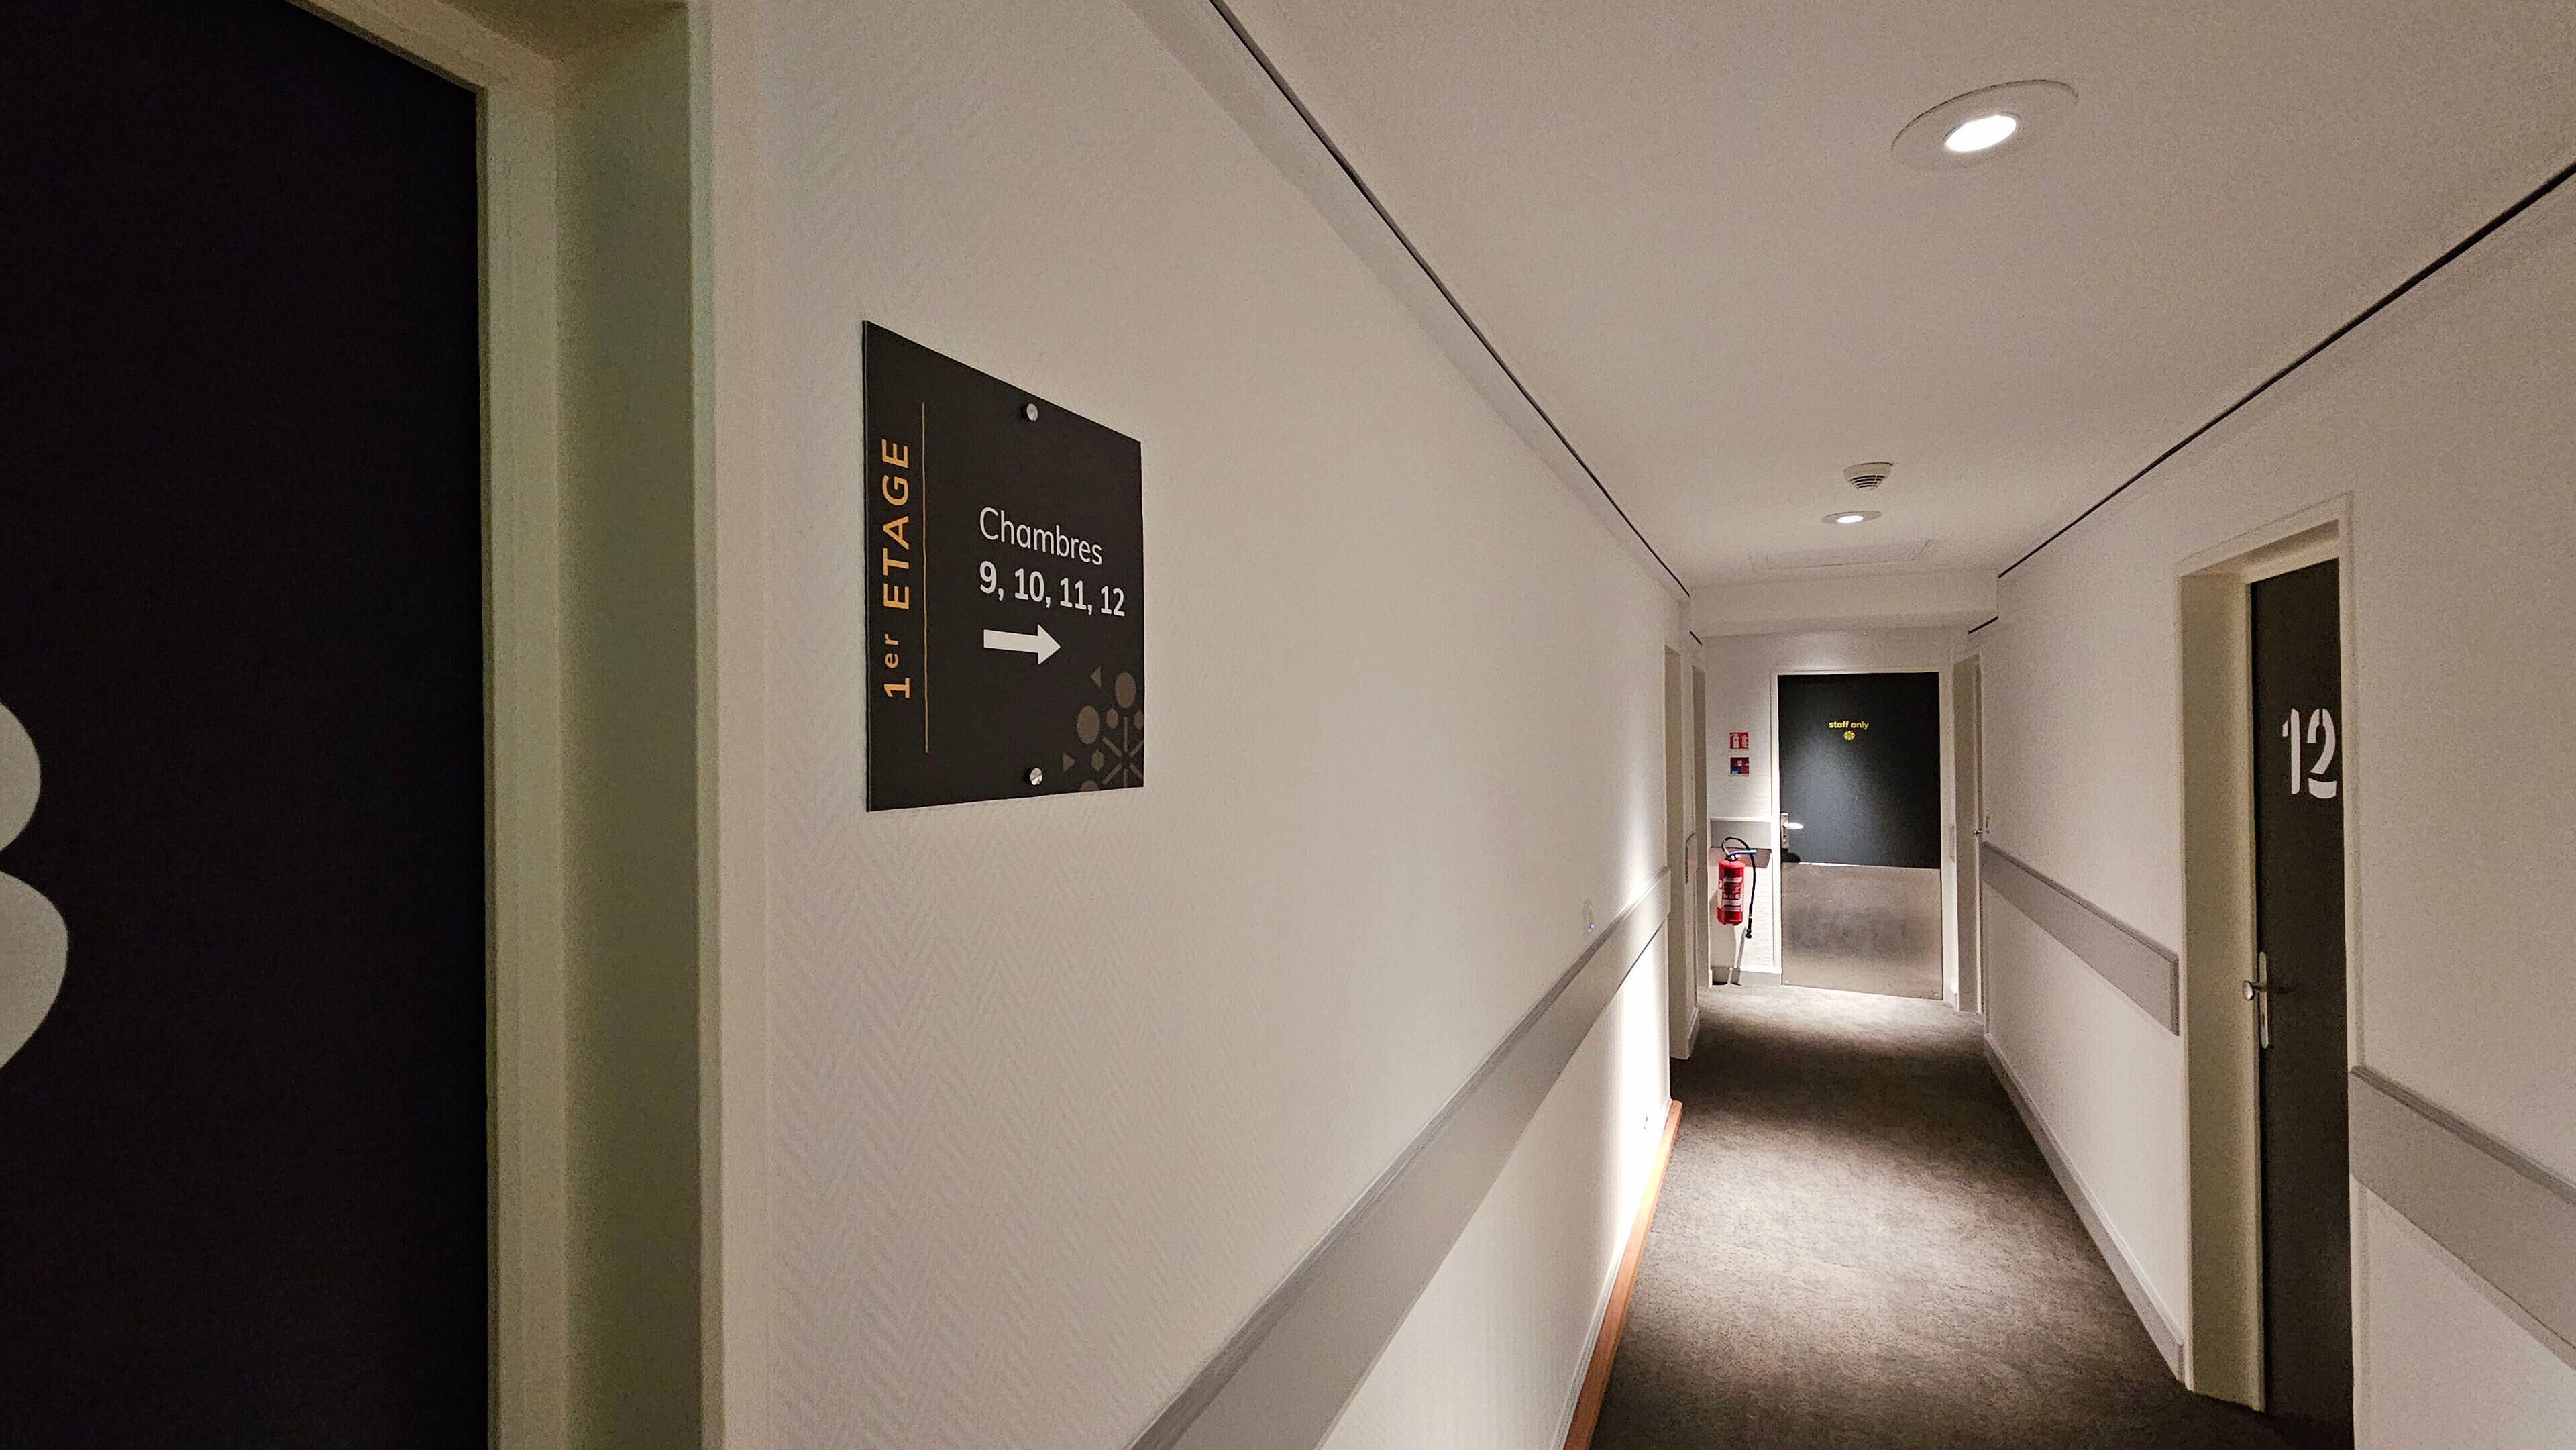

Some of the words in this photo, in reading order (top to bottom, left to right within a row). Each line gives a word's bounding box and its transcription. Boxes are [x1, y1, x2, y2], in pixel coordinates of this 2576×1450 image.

[881, 439, 910, 610] ETAGE
[979, 506, 1103, 566] Chambres
[979, 560, 1004, 601] 9,
[1014, 568, 1052, 609] 10,
[1059, 577, 1093, 615] 11,
[1100, 586, 1126, 617] 12
[883, 633, 910, 698] 1er
[1828, 720, 1849, 729] staff
[1850, 721, 1869, 730] only
[2282, 707, 2337, 799] 12
